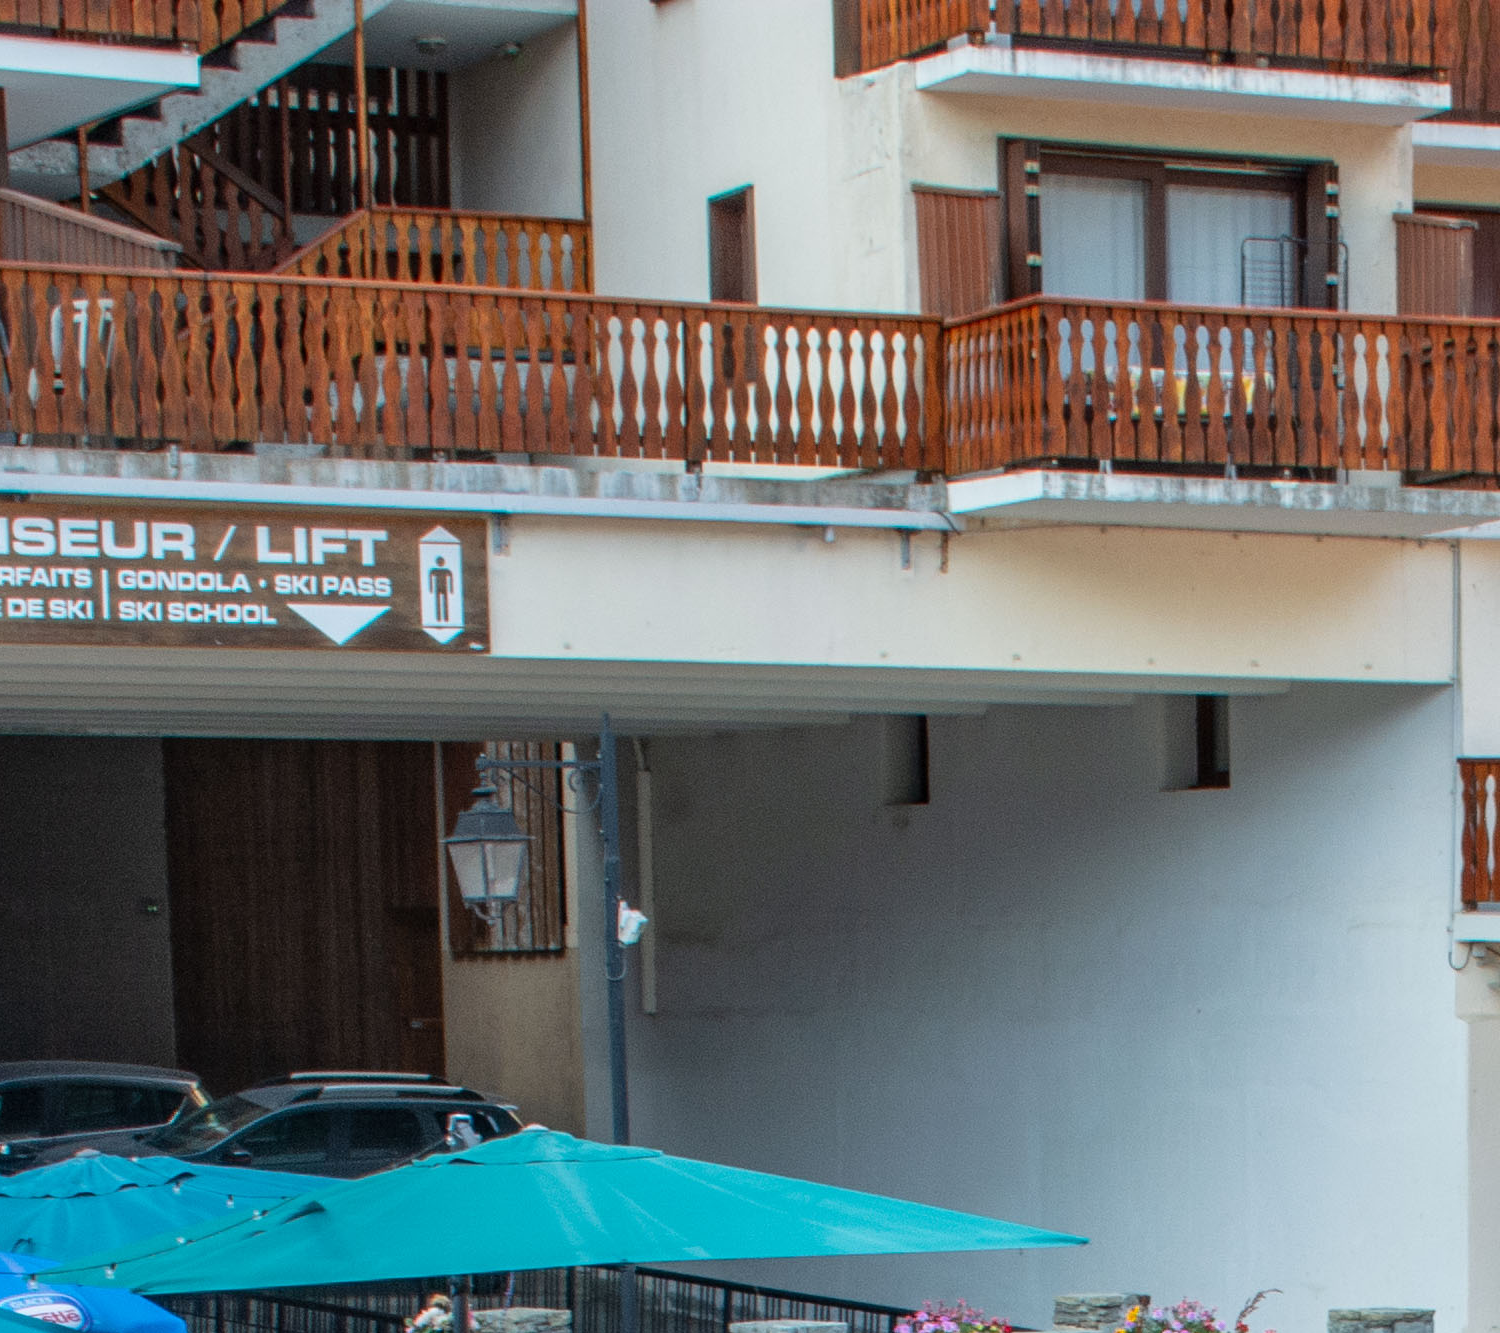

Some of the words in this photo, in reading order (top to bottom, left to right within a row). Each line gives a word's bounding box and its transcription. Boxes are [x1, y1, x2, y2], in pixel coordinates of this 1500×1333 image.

[257, 526, 389, 565] LIFT
[117, 570, 252, 594] GONDOLA
[274, 574, 317, 595] SKI
[321, 576, 393, 598] PASS
[7, 598, 44, 618] DE
[48, 599, 95, 619] SKI
[117, 601, 162, 622] SKI
[166, 603, 278, 626] SCHOOL
